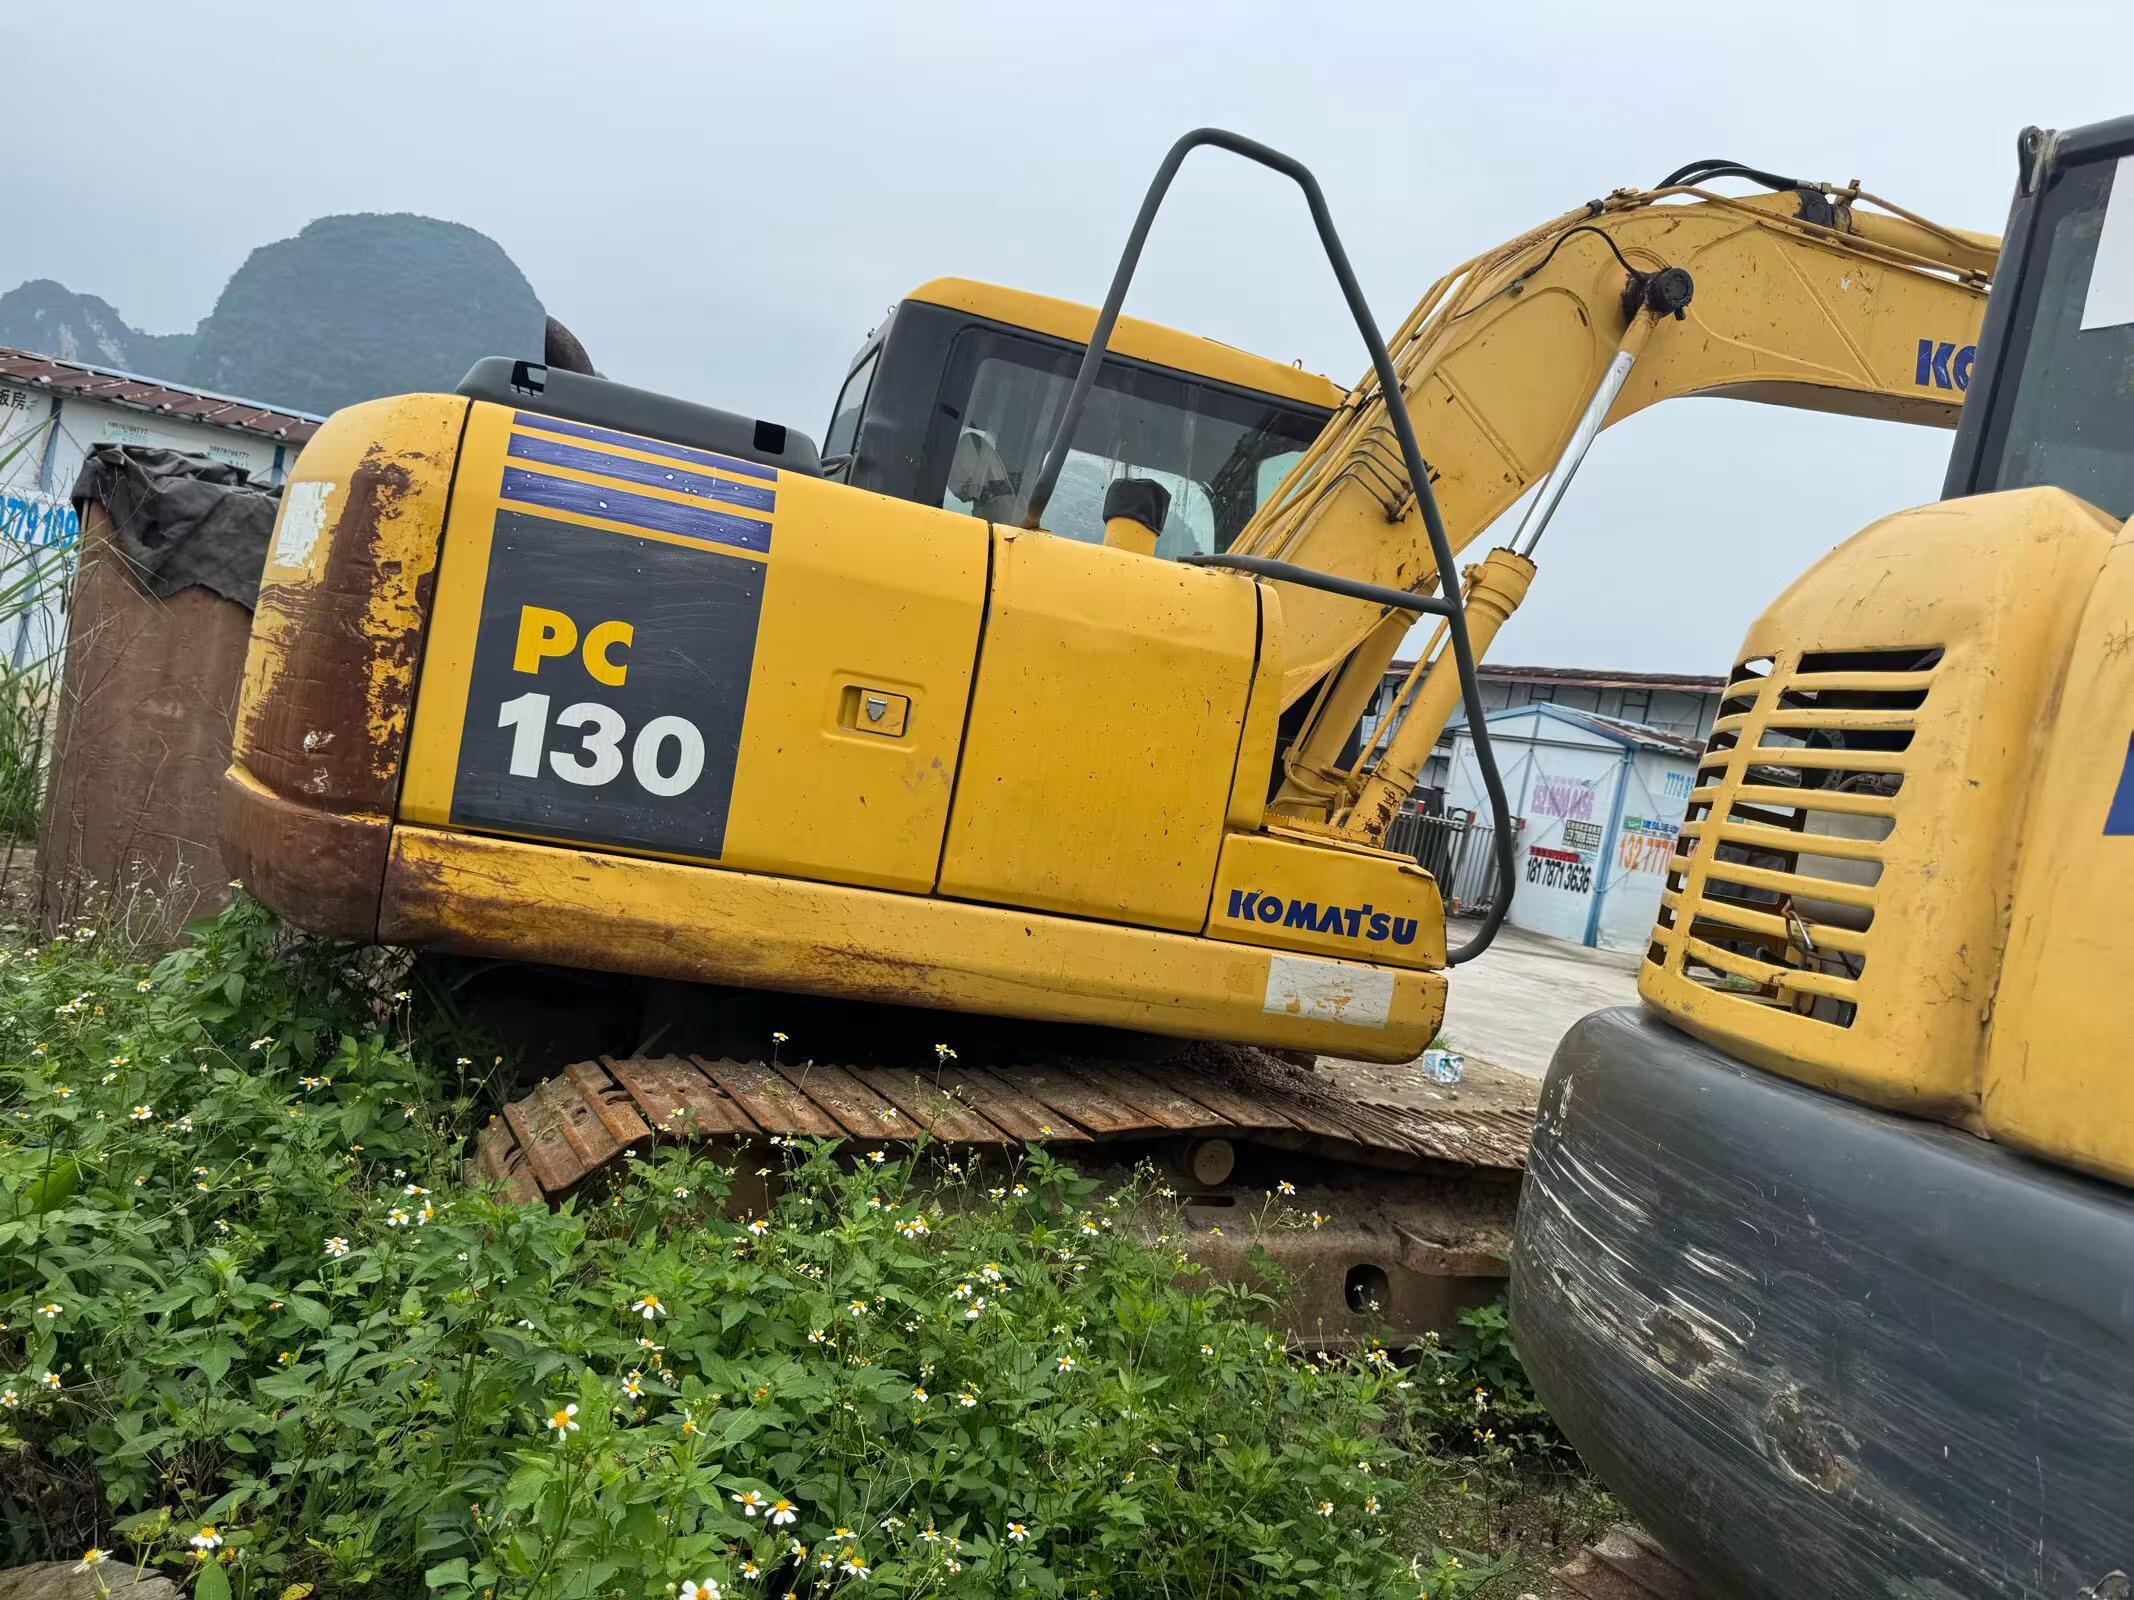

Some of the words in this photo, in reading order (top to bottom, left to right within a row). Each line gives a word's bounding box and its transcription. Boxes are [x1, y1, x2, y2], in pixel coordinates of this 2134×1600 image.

[513, 604, 634, 686] PC
[498, 692, 705, 797] 130
[1227, 889, 1418, 945] KOMATSU
